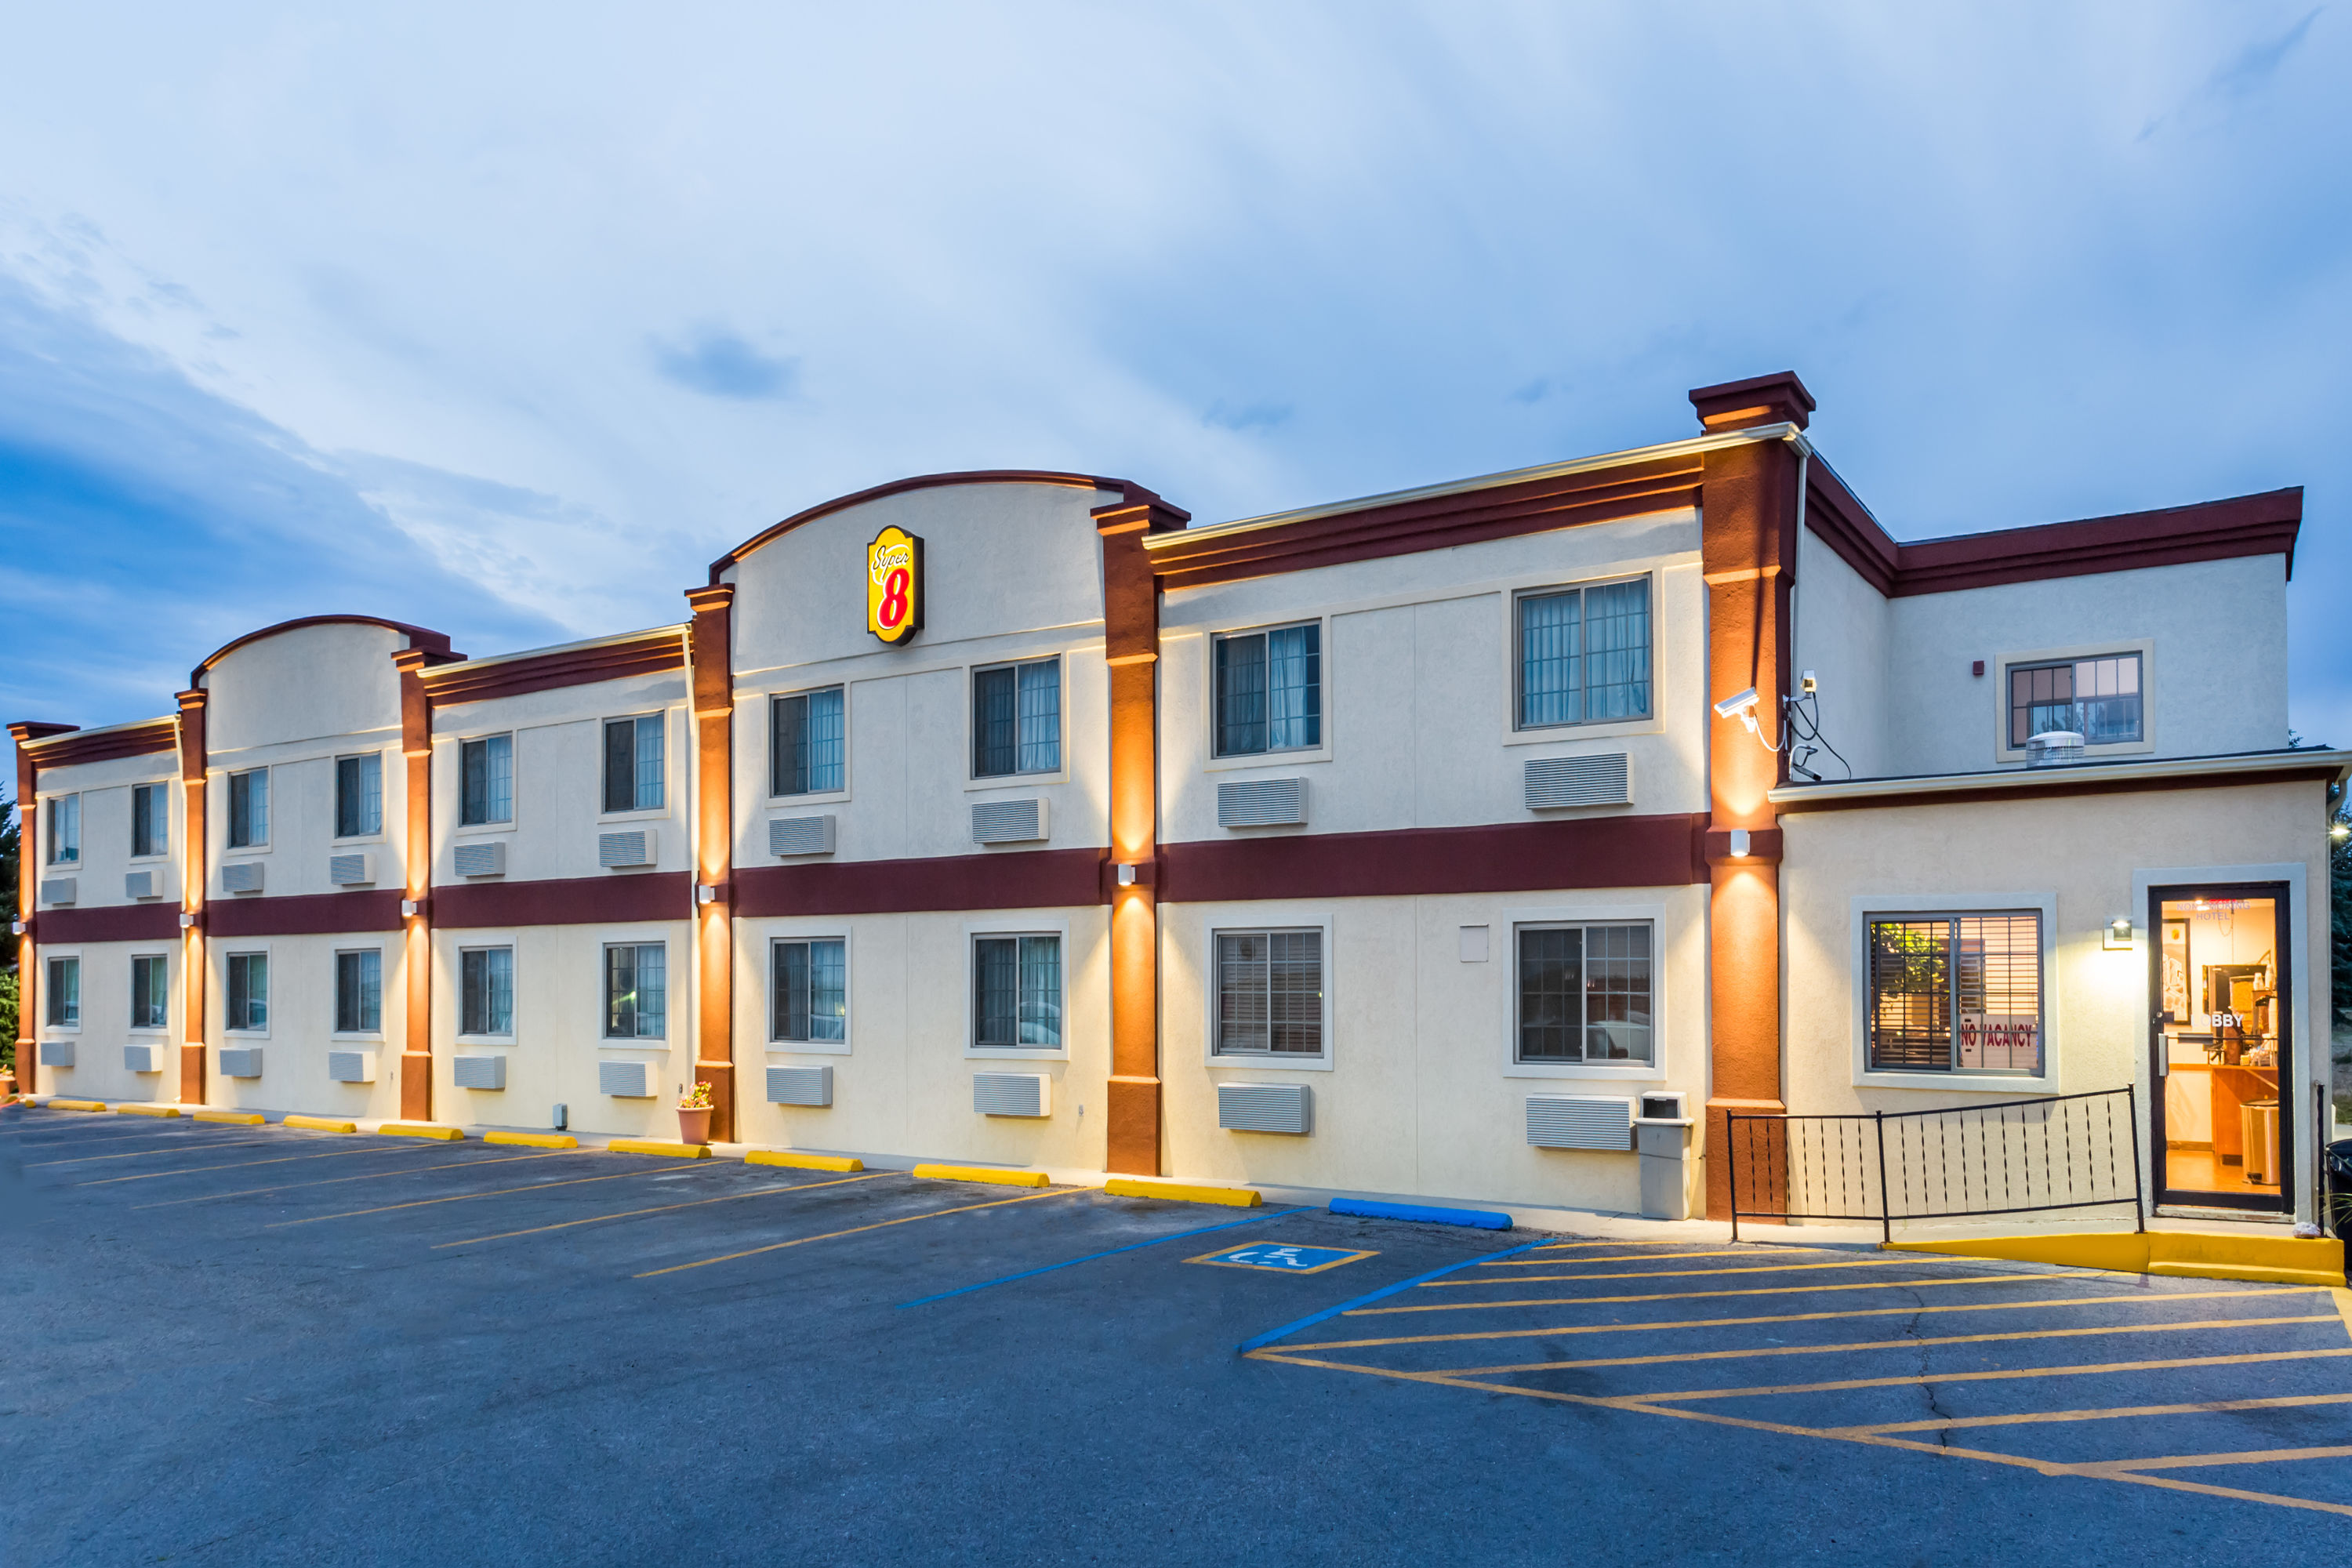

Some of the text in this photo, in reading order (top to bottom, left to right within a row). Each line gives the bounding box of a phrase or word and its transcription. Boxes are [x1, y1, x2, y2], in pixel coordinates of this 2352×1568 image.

[872, 545, 909, 582] Super
[877, 568, 909, 630] 8
[2196, 911, 2230, 921] HOTEL
[1961, 1023, 2031, 1047] NO VACANCY
